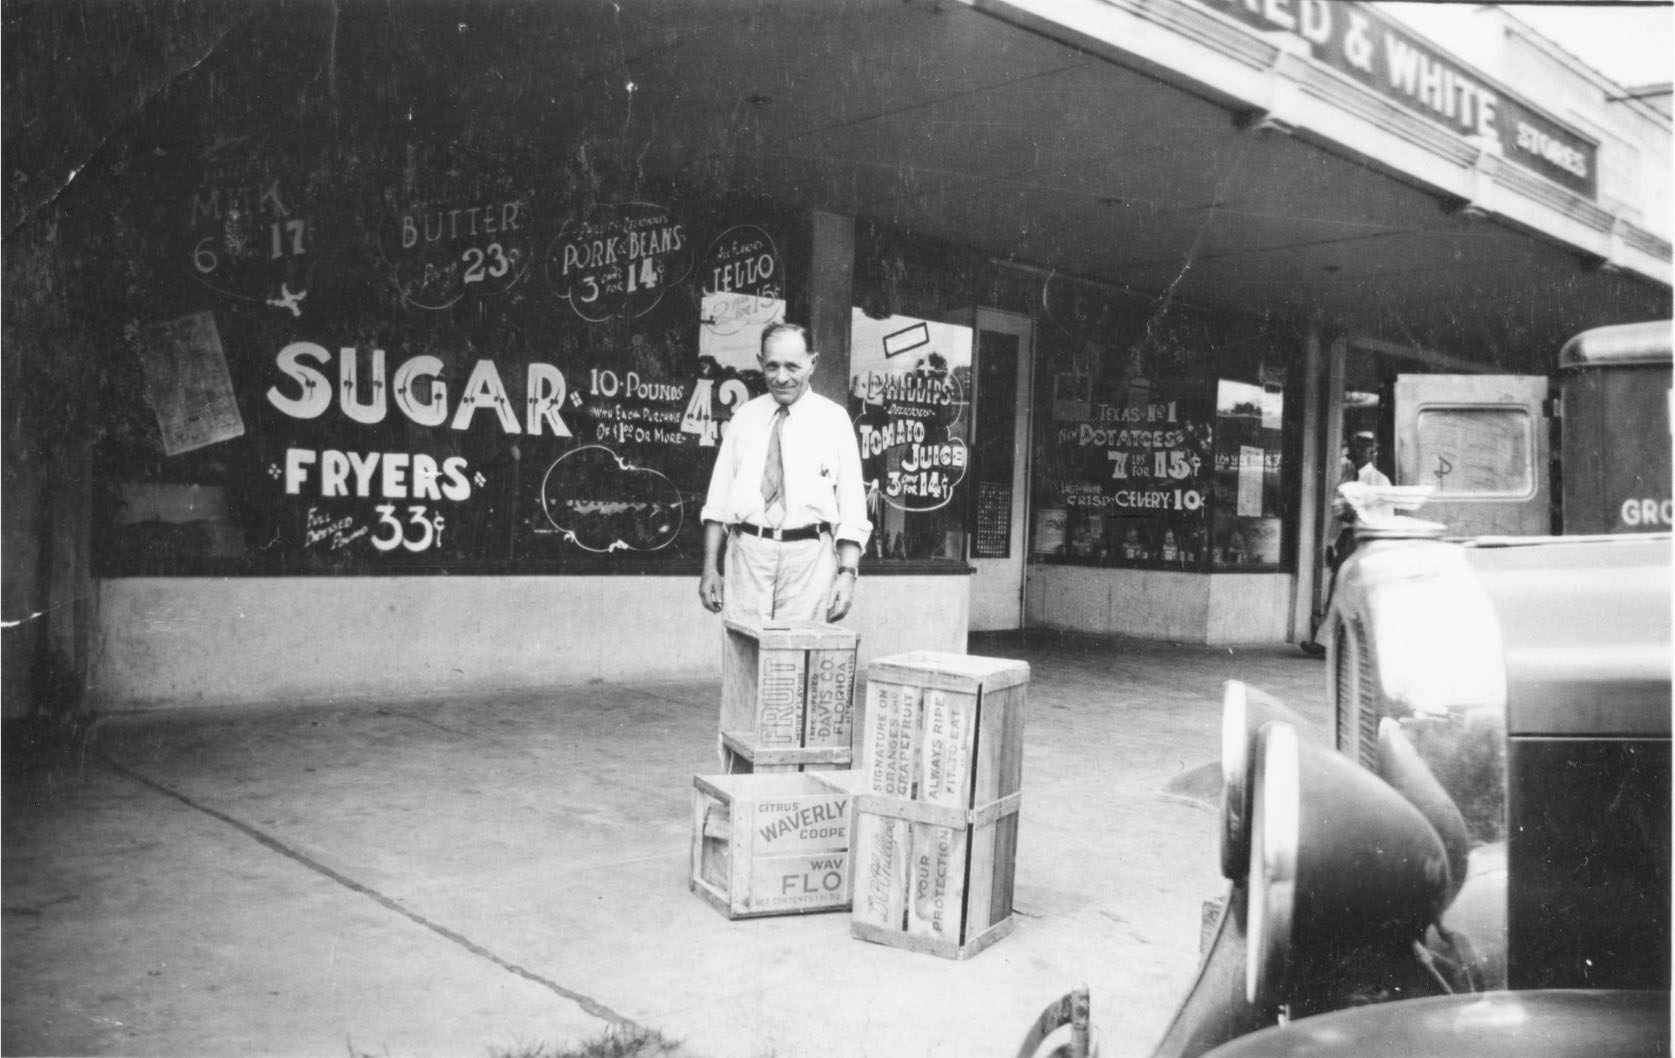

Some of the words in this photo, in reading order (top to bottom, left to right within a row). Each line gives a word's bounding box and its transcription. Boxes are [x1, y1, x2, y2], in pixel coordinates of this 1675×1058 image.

[1342, 9, 1373, 74] &
[1384, 32, 1499, 137] WHITE
[1516, 121, 1588, 178] STORES
[402, 201, 522, 249] BUTTER
[562, 236, 619, 276] PORK
[628, 224, 683, 261] BEANS
[580, 275, 599, 303] 3
[267, 341, 574, 438] SUGAR
[590, 368, 618, 397] 10
[626, 371, 686, 402] POUNDS
[1098, 403, 1141, 423] TEXAS
[1167, 400, 1178, 423] 1
[635, 427, 652, 443] OR
[859, 419, 925, 460] TOMATO
[285, 447, 472, 501] FRYERS
[901, 443, 967, 472] JUICE
[1107, 450, 1129, 479] 7
[1154, 450, 1202, 480] 15¢
[886, 471, 901, 496] 3
[1115, 490, 1171, 509] CELERY
[370, 503, 446, 552] 33¢
[760, 656, 796, 744] FRUIT
[818, 689, 833, 738] DAVIS
[833, 662, 847, 735] FLORIDA
[878, 689, 889, 710] ON
[932, 696, 945, 735] RIPE
[897, 692, 914, 796] GRAPEFRUIT
[949, 708, 961, 740] EAT
[872, 713, 887, 793] SIGNATURE
[885, 718, 899, 794] ORANGES
[928, 739, 943, 800] ALWAYS
[758, 802, 799, 813] CITRUS
[760, 799, 847, 843] WAVERLY
[782, 871, 842, 895] FLO
[810, 858, 844, 871] WAV
[918, 855, 930, 900] YOUR
[932, 829, 948, 932] PROTECTION
